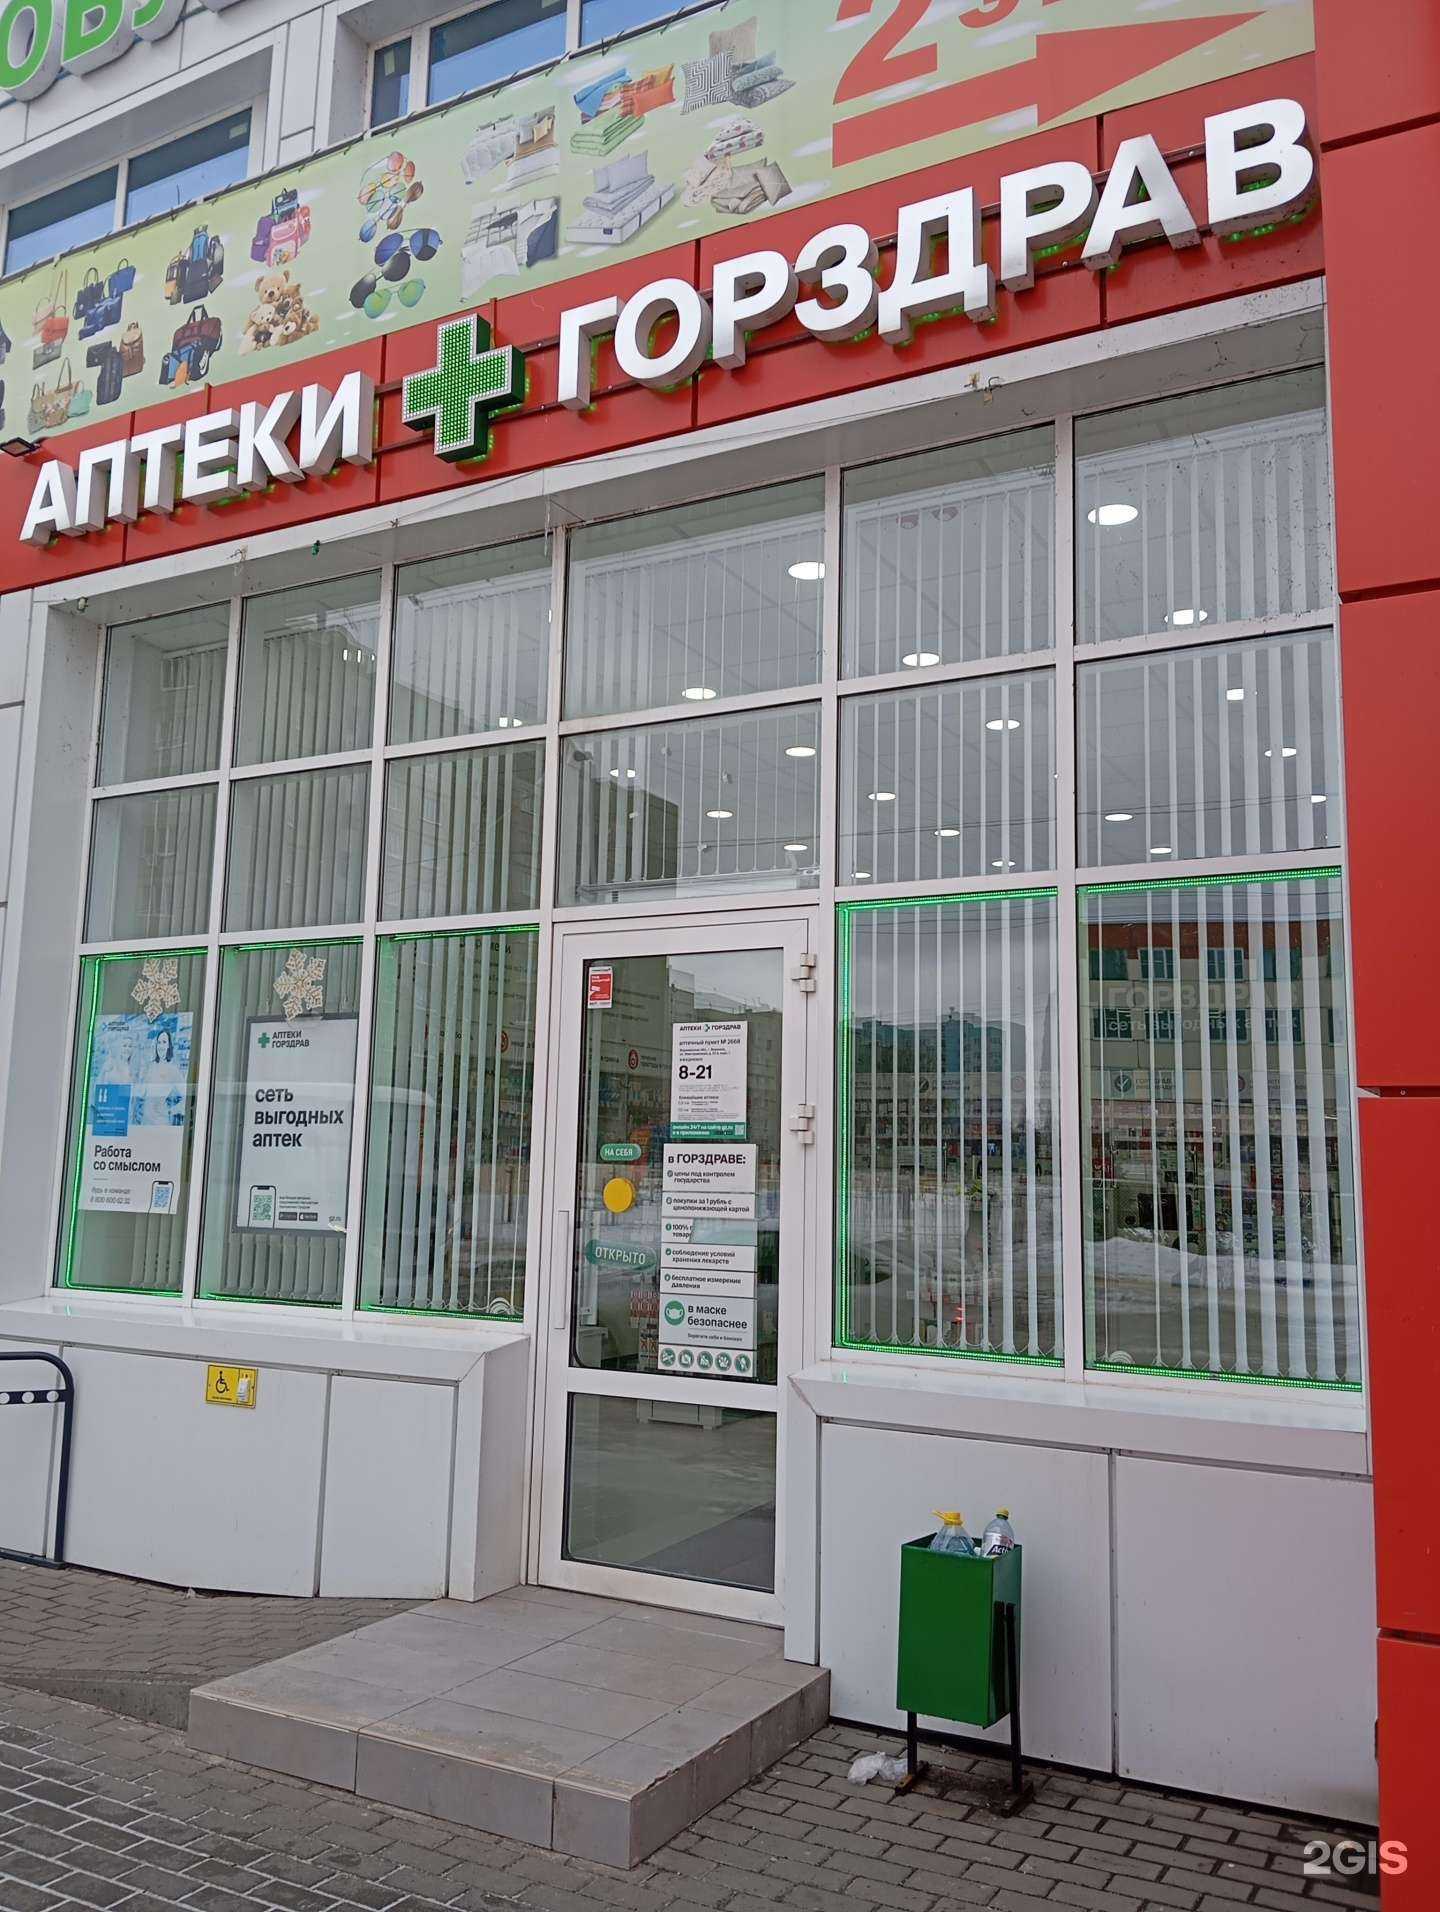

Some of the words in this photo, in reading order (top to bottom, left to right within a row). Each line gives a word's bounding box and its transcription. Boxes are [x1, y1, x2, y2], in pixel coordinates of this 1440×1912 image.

[20, 371, 372, 544] АПТЕКИ
[557, 98, 1316, 411] ГОРЗДРАВ
[272, 1030, 302, 1040] АПТЕКИ
[272, 1039, 310, 1048] ГОРЗДРАВ
[678, 1064, 712, 1080] 8-21
[255, 1088, 294, 1103] сеть
[254, 1110, 344, 1127] выгодных
[252, 1133, 303, 1148] аптек
[94, 1145, 132, 1158] Работа
[604, 1148, 615, 1156] НА
[615, 1148, 633, 1157] СЕБЯ
[668, 1156, 675, 1164] в
[677, 1154, 746, 1165] ГОРЗДРАВЕ:
[93, 1160, 107, 1171] со
[108, 1161, 161, 1173] смыслом
[595, 1246, 646, 1265] ОТКРЫТО
[671, 1274, 706, 1282] бесплатное
[696, 1306, 727, 1315] маске
[687, 1316, 748, 1329] безопаснее
